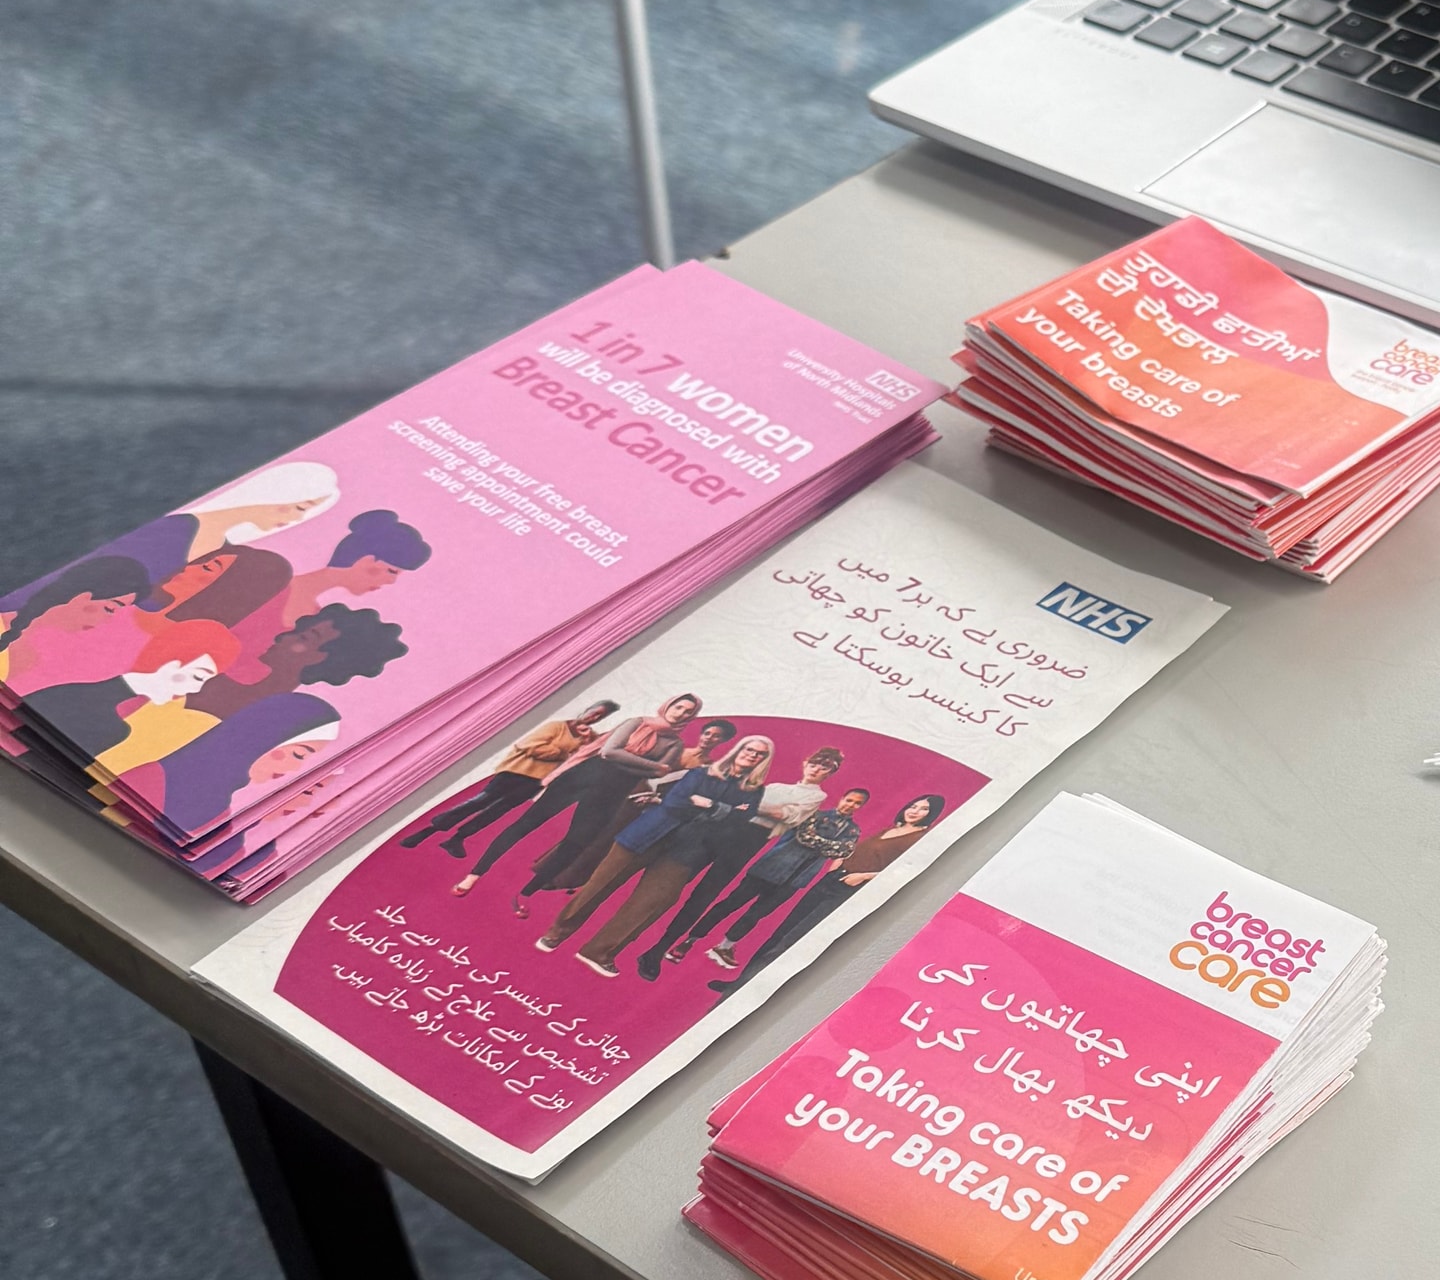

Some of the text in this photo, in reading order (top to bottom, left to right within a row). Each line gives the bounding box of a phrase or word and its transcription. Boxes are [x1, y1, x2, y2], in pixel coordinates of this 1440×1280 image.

[1096, 268, 1139, 298] ਦੀ
[570, 321, 613, 345] 1
[597, 332, 645, 365] in
[637, 353, 685, 376] 7
[1015, 307, 1183, 418] your breasts
[1056, 289, 1242, 407] Taking care of
[1212, 312, 1322, 362] ਛਾਤੀਆਂ
[783, 360, 884, 418] of North Midlands
[788, 349, 897, 411] University Hospitals
[868, 371, 918, 400] NHS
[1370, 358, 1434, 385] care
[492, 356, 747, 506] Breast Cancer
[537, 341, 783, 485] will be diagnosed with
[387, 419, 623, 568] screening appointment could
[419, 416, 629, 548] Attending your free breast
[423, 467, 532, 537] save your life
[837, 557, 890, 583] میں
[772, 569, 1054, 710] سے ایک خاتون کو چھاتی
[793, 628, 829, 649] ہے
[937, 604, 977, 622] کہ
[962, 626, 998, 646] ہے
[1040, 586, 1150, 642] NHS
[996, 640, 1089, 680] ضروری
[907, 687, 1001, 724] کینسر
[994, 715, 1029, 737] کا
[1190, 921, 1312, 982] cancer
[1206, 891, 1327, 968] breast
[327, 915, 610, 1086] تشخیص سے علاج کے زیادہ کامیاب
[365, 986, 410, 1013] جاتے
[373, 905, 632, 1065] چھاتی کے کینسر کی جلد سے جلد
[1169, 940, 1291, 1009] care
[409, 1009, 445, 1036] بڑھ
[918, 963, 1223, 1104] اپنی چھاتیوں کی
[443, 1030, 520, 1075] امکانات
[899, 1000, 1154, 1141] دیکھ بھال کرنا
[503, 1075, 546, 1093] کے
[528, 1089, 574, 1113] ہونے
[835, 1048, 1130, 1203] Taking care of
[784, 1093, 1091, 1246] your BREASTS
